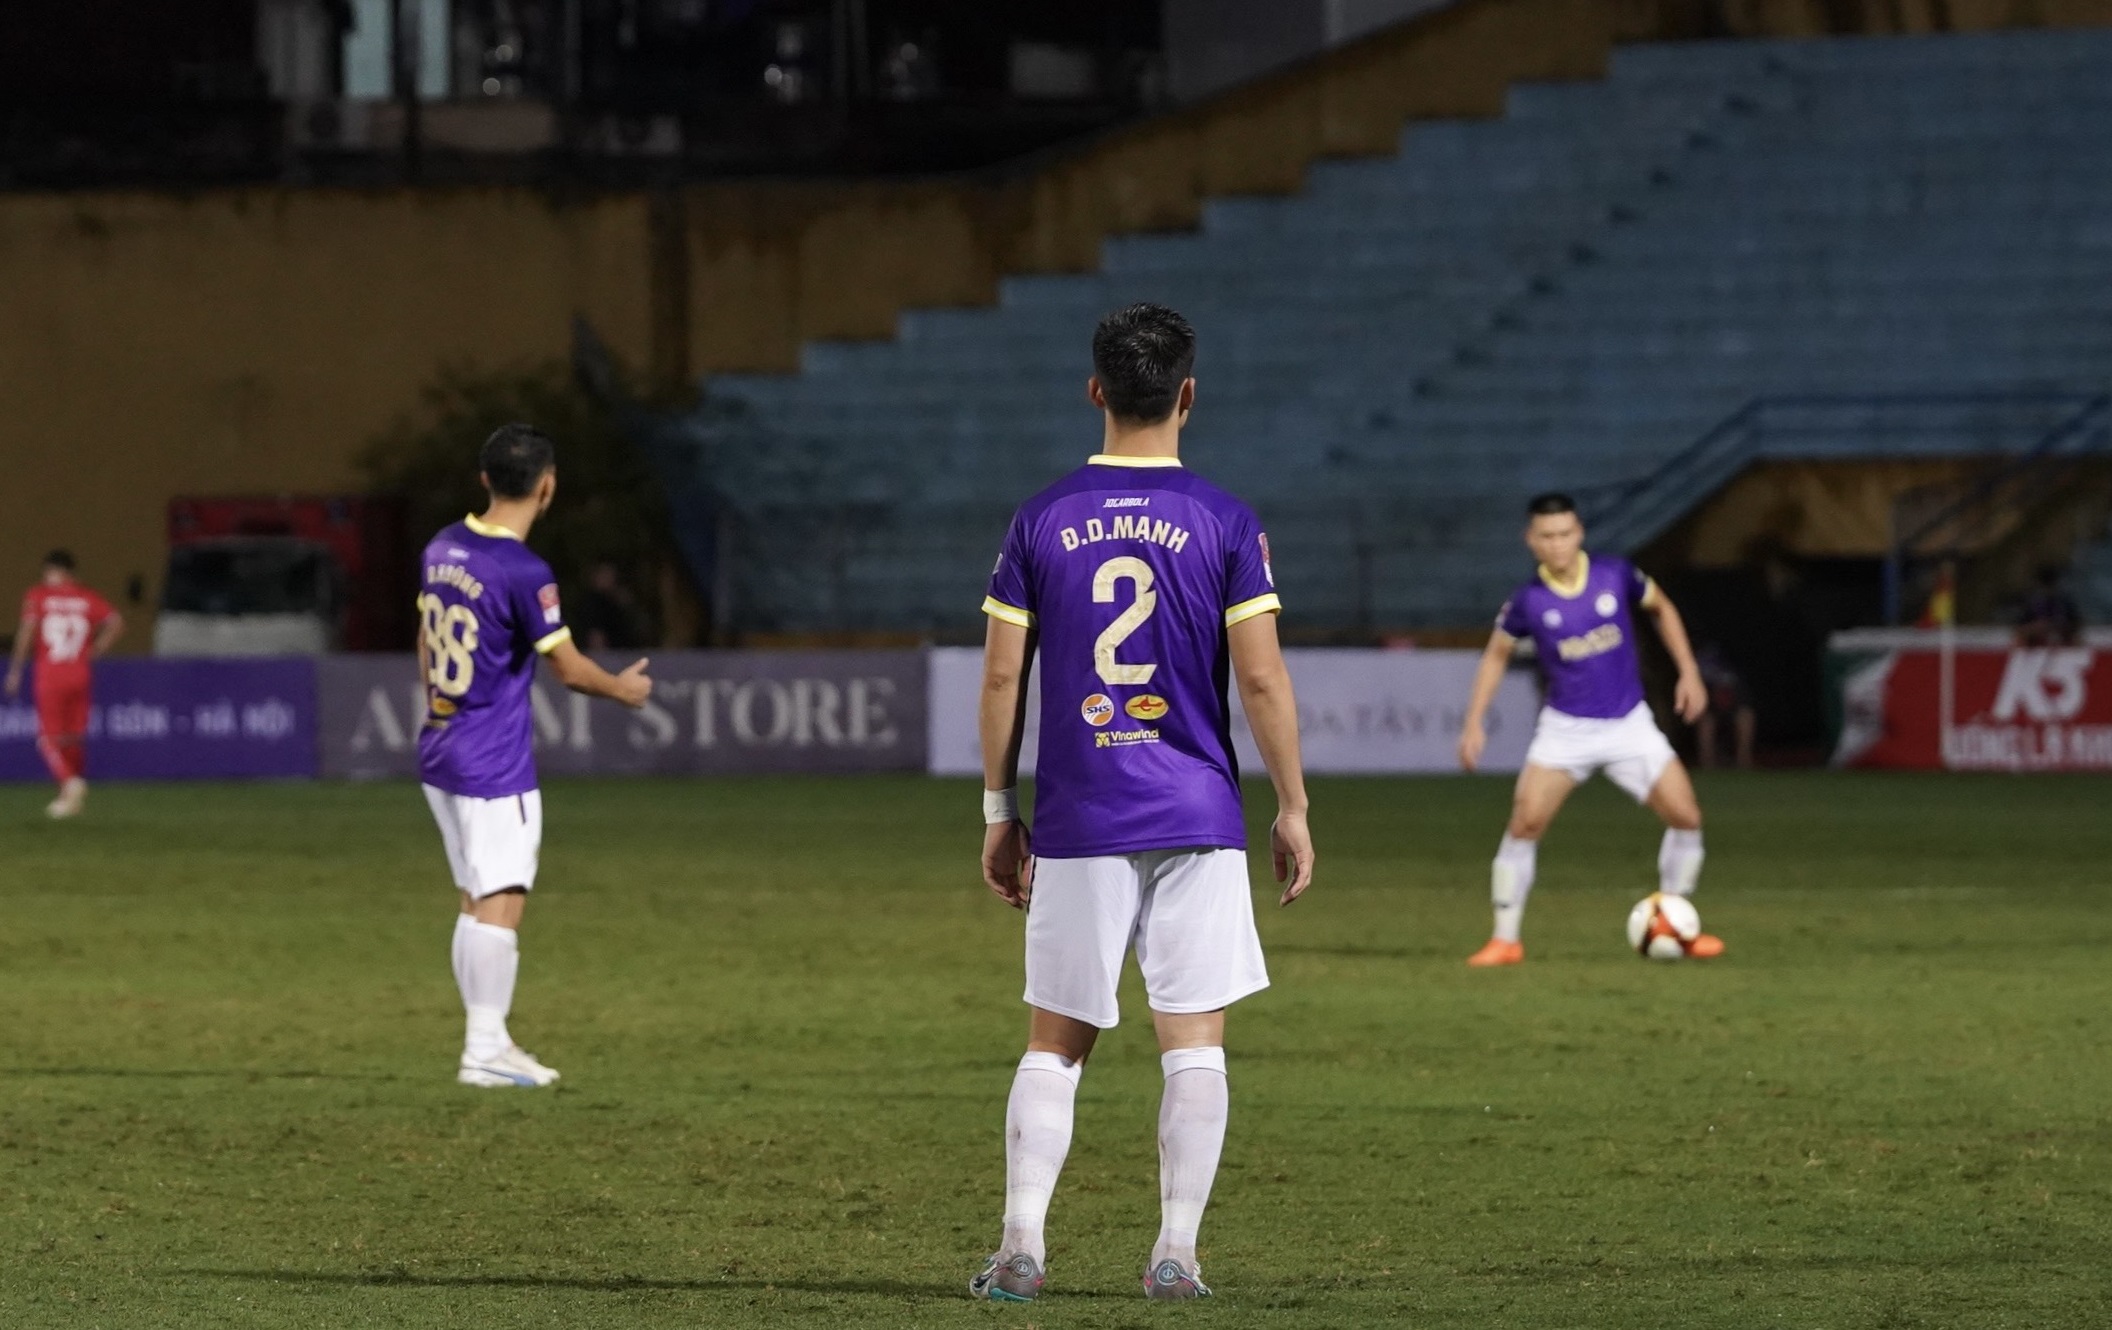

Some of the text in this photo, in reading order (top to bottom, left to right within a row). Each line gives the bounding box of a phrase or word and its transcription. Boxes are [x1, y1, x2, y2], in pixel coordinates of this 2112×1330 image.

[1060, 515, 1190, 553] Đ.D.MẠNH
[424, 593, 479, 696] 88
[1092, 556, 1157, 685] 2
[625, 677, 896, 750] STORE
[1087, 706, 1110, 714] SHS
[1110, 728, 1159, 741] Vinawind
